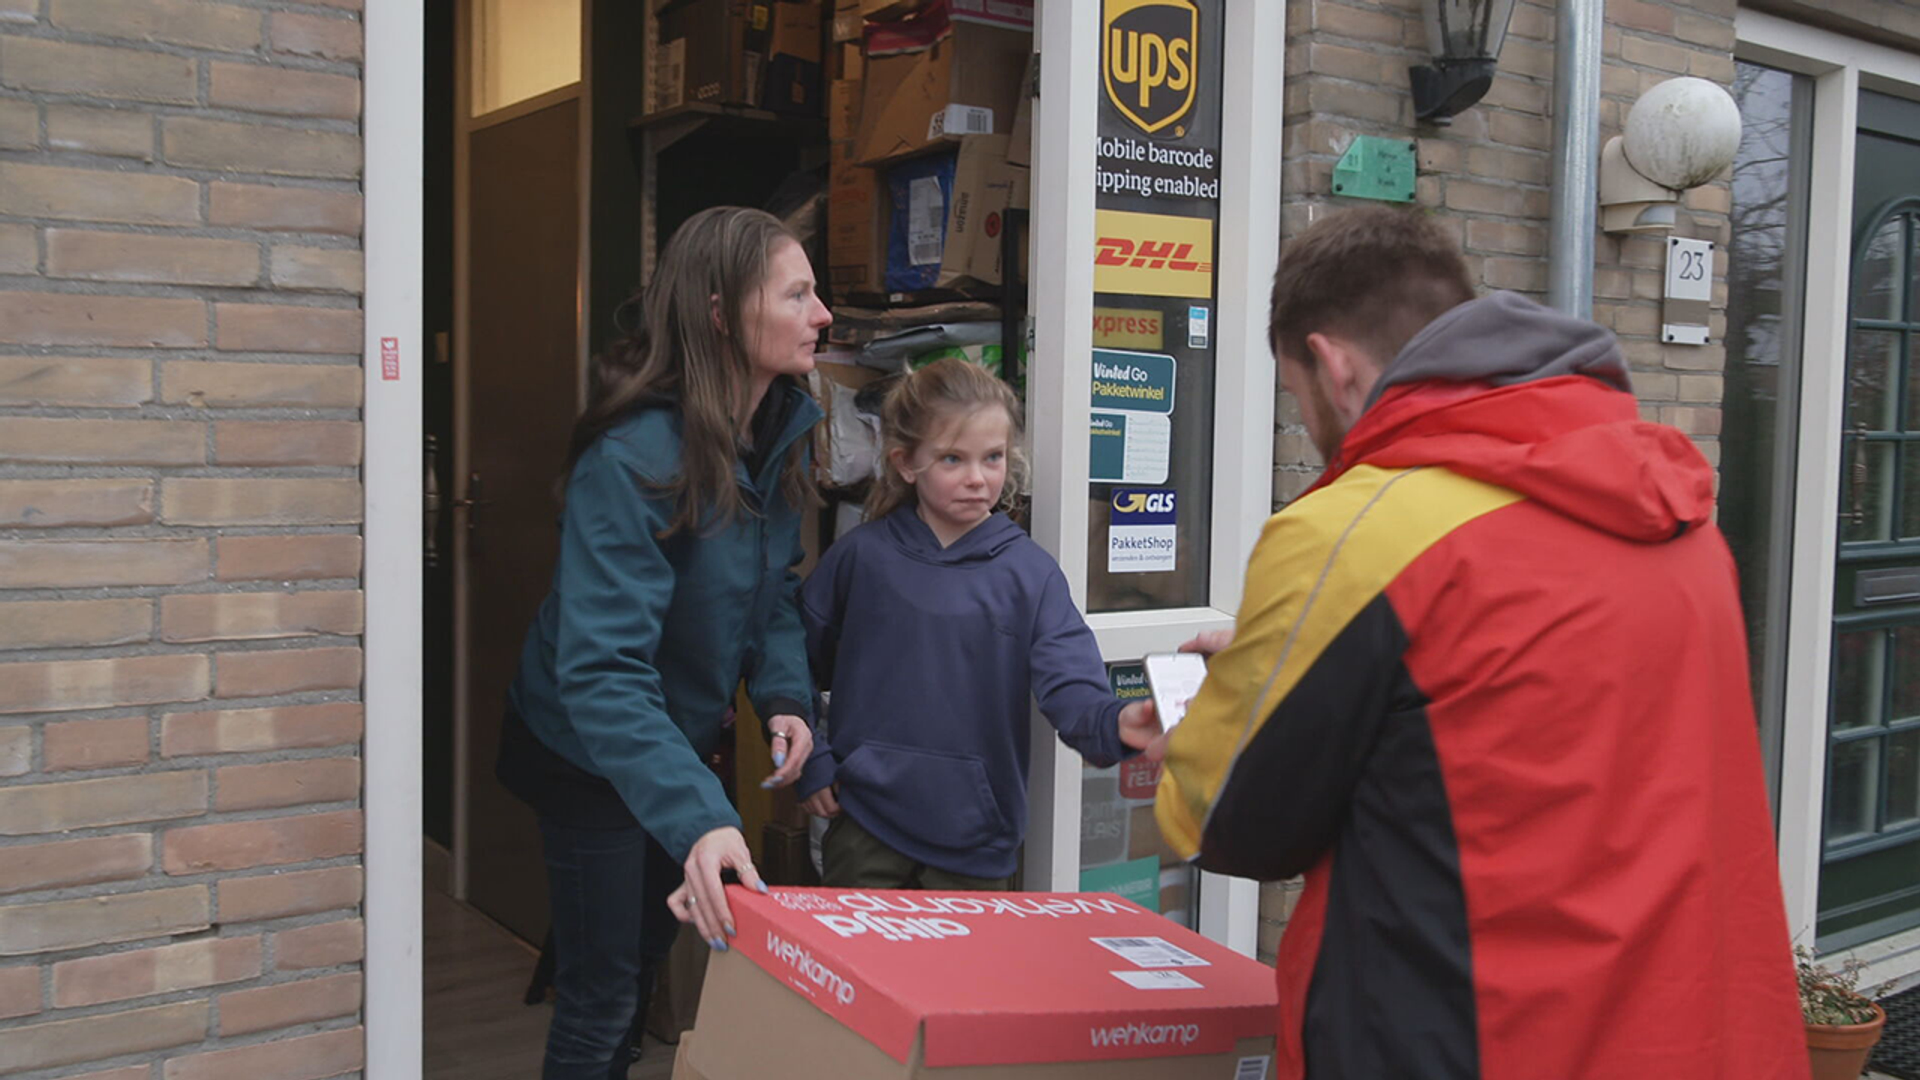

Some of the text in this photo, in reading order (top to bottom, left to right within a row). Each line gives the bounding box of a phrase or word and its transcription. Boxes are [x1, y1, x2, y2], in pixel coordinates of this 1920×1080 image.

[1112, 28, 1190, 108] ups
[1148, 142, 1214, 169] barcode
[1154, 176, 1218, 199] enabled
[1094, 237, 1199, 271] DHL
[1679, 250, 1704, 281] 23
[1093, 362, 1148, 382] Vinted Go
[1092, 381, 1164, 400] Pakketwinkel
[1146, 493, 1175, 513] GLS
[1111, 537, 1174, 551] PakketShop
[838, 891, 1141, 919] wehkamp
[813, 911, 971, 942] altijd
[767, 930, 855, 1005] wehkamp
[1091, 1021, 1199, 1047] wehkamp
